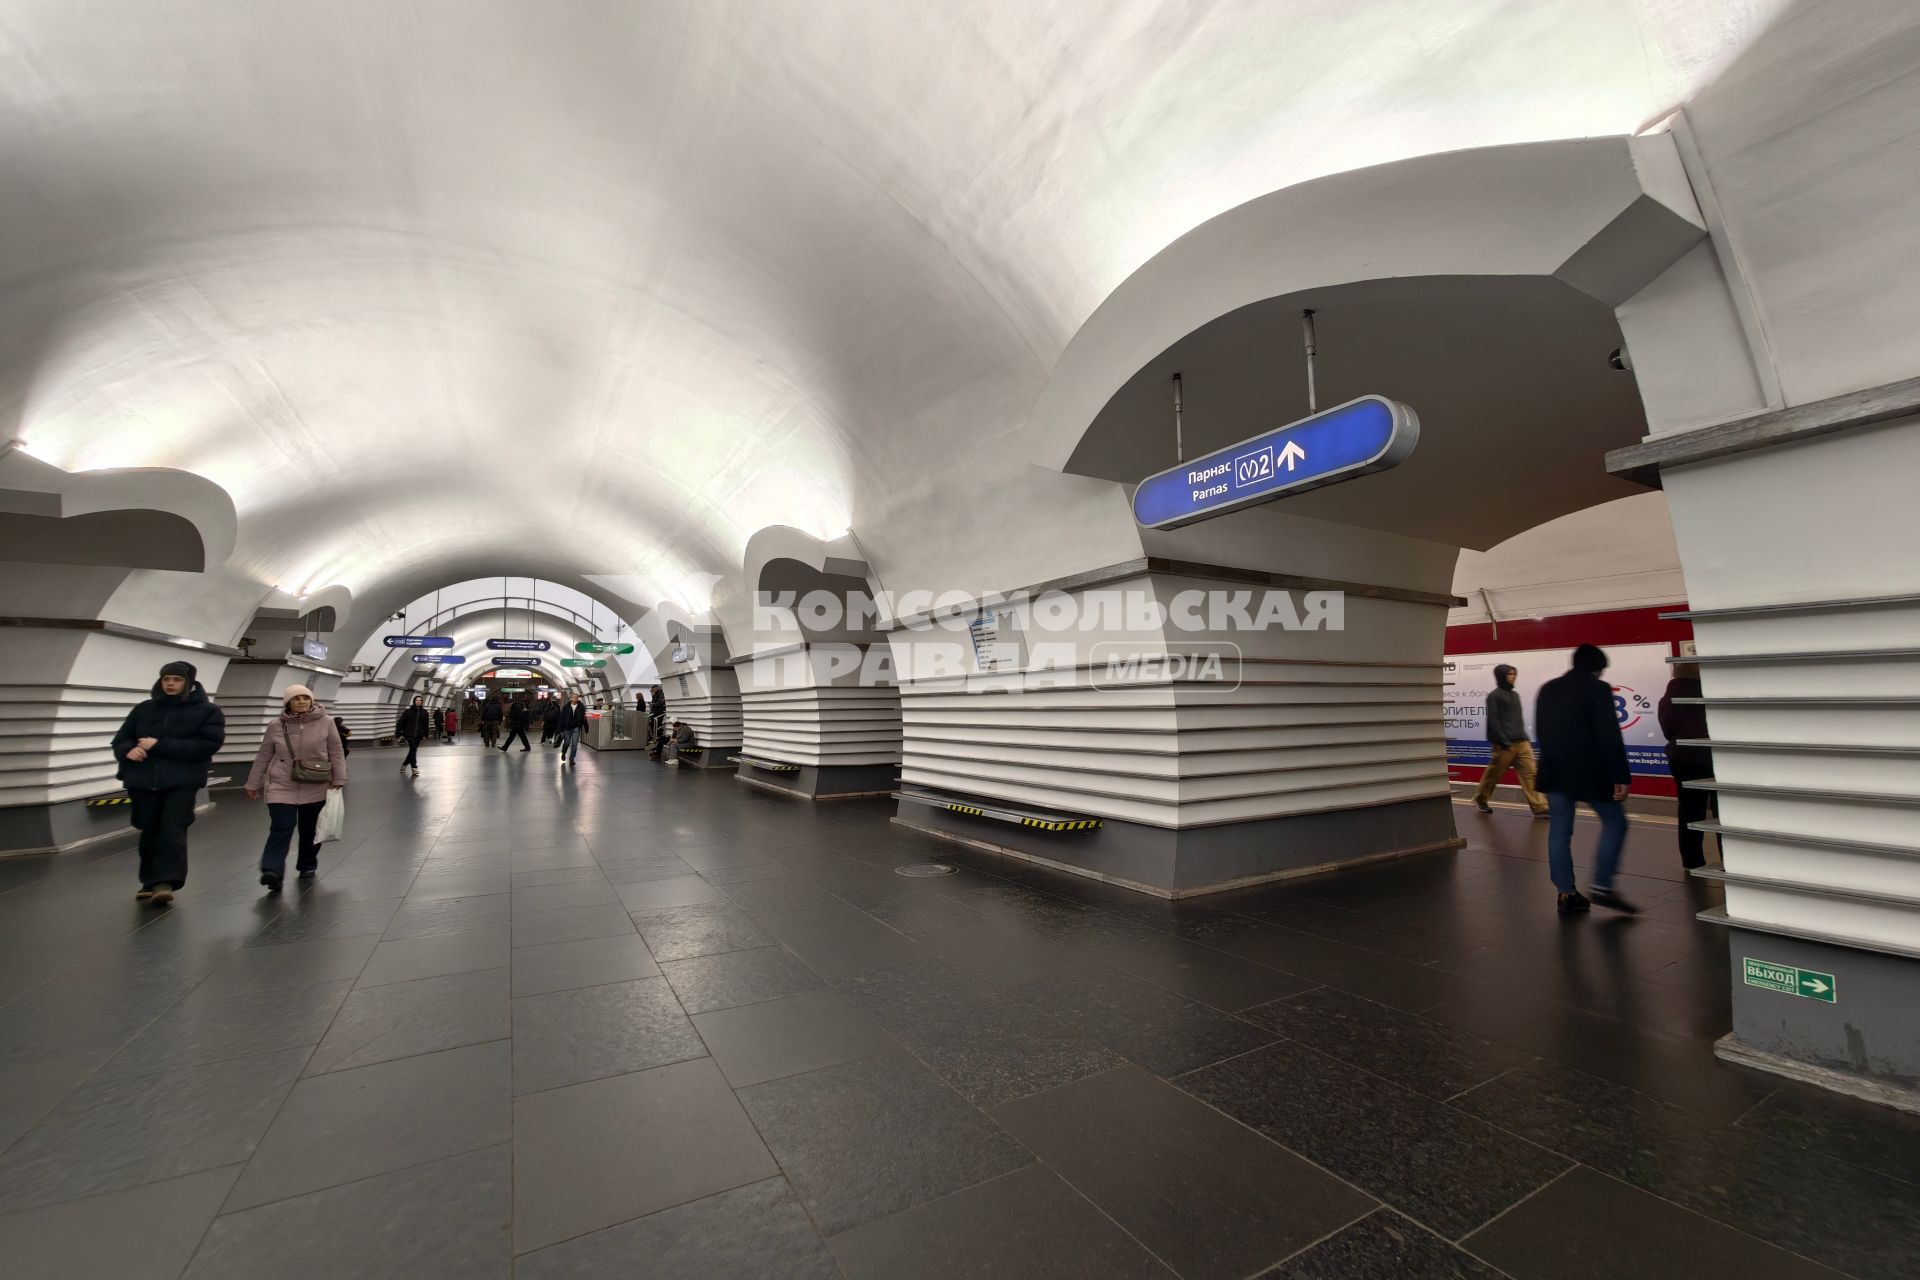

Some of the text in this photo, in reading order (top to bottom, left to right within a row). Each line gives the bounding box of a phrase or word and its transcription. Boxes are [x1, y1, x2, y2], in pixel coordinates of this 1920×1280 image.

[1188, 461, 1232, 485] Парнас
[1192, 483, 1228, 502] Parnas
[1747, 965, 1795, 986] ВЫХОД
